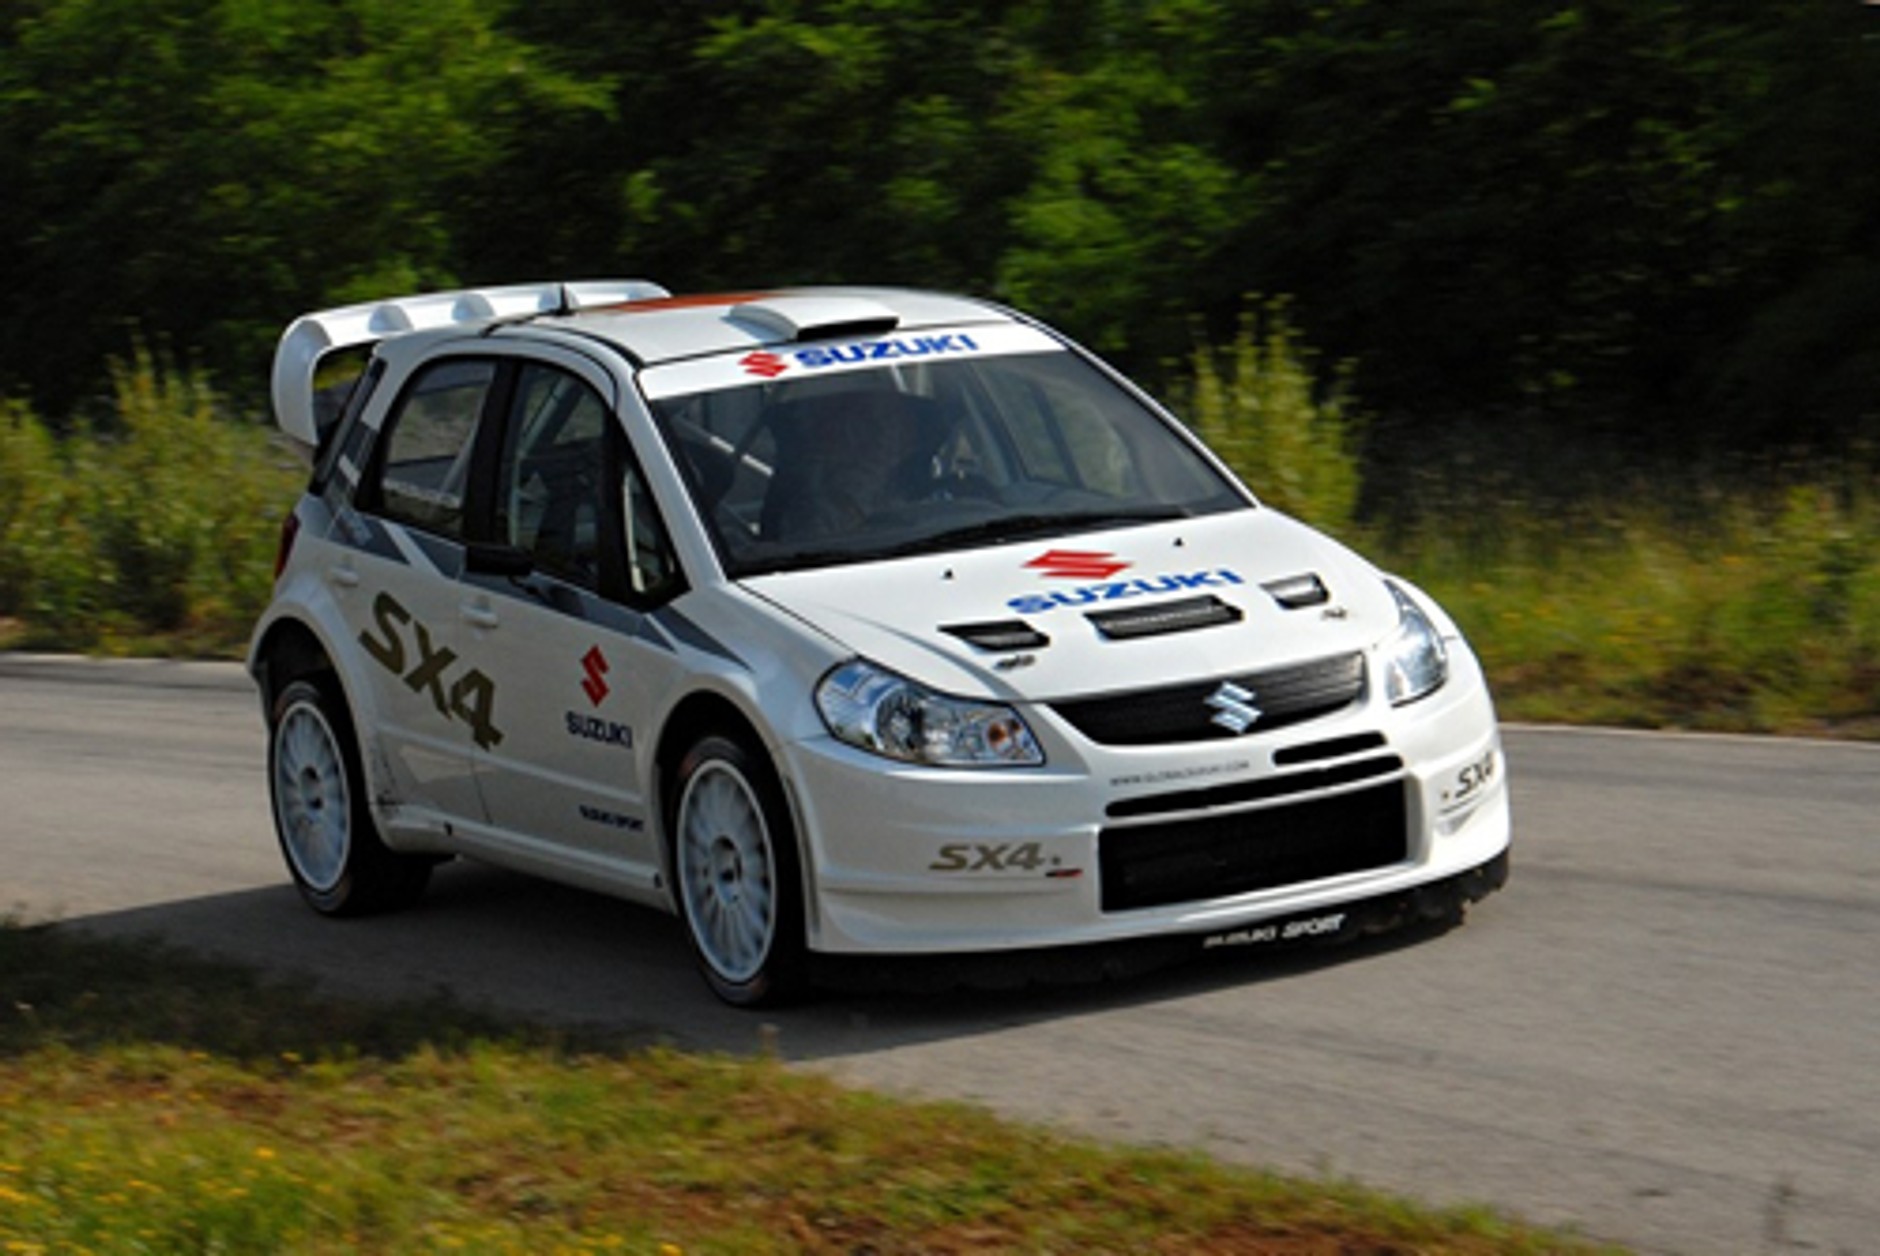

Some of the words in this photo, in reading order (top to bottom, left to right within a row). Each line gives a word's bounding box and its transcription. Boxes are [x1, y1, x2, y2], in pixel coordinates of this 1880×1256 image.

[795, 333, 979, 368] SUZUKI
[1007, 569, 1244, 614] SUZUKI
[357, 590, 505, 752] SX4
[565, 710, 633, 749] SUZUKI
[929, 842, 1046, 871] SX4
[1282, 913, 1346, 938] SPORT
